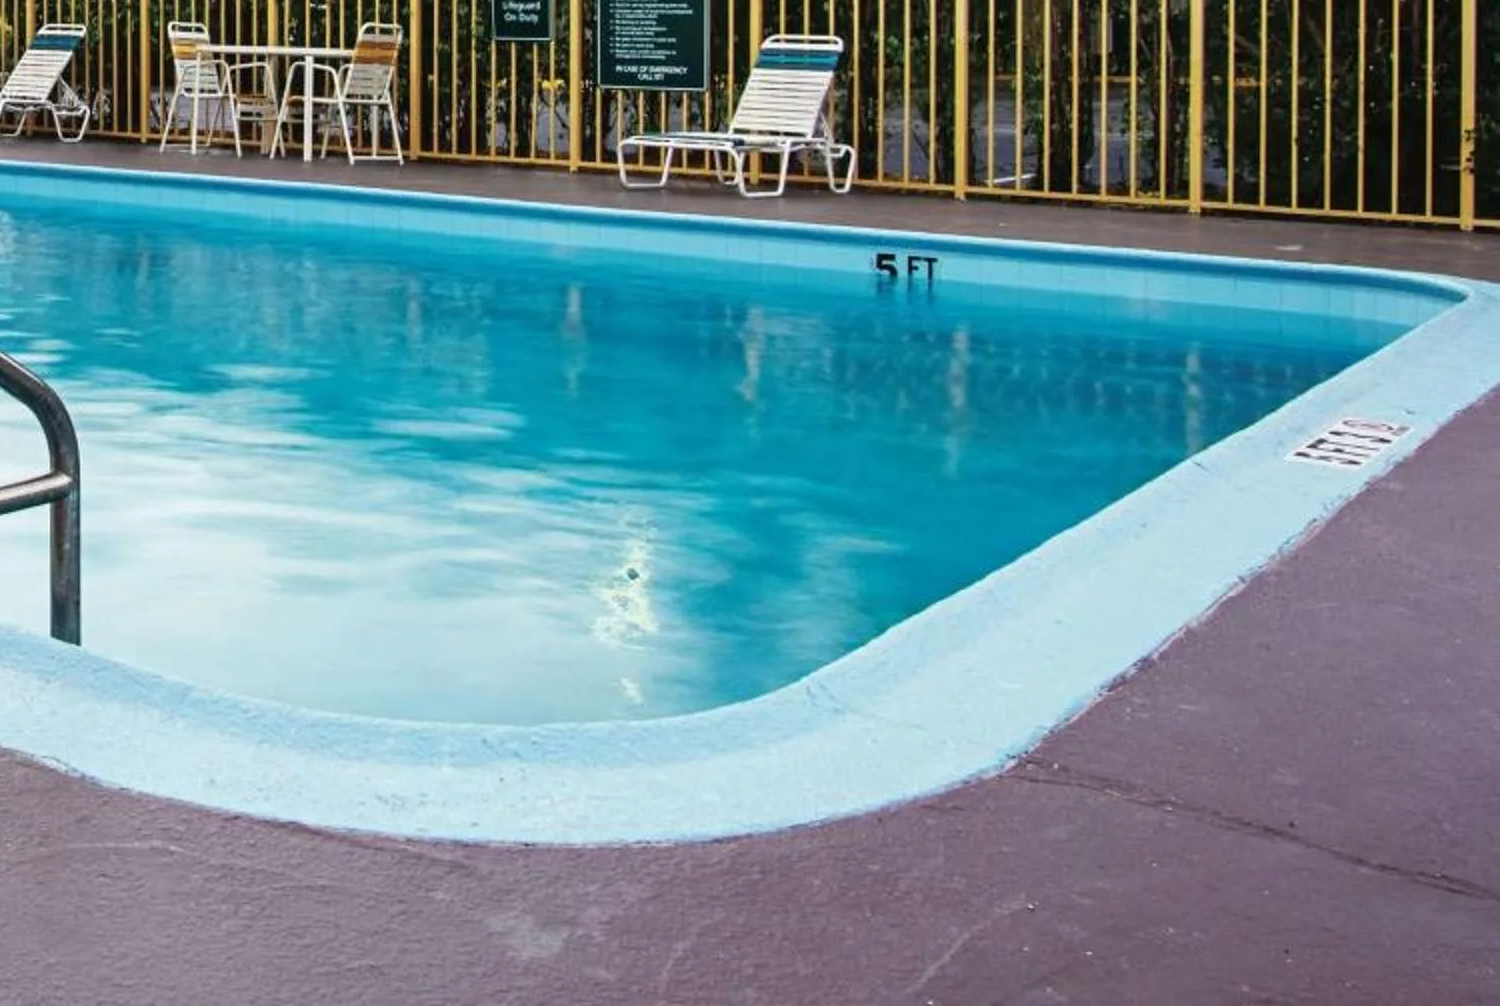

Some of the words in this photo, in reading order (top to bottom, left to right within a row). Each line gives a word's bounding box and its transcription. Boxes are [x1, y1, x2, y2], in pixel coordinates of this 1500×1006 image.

[502, 1, 541, 12] Lifeguard
[503, 12, 517, 22] On
[518, 13, 539, 26] Duty
[876, 253, 898, 280] 5
[907, 255, 938, 281] FT
